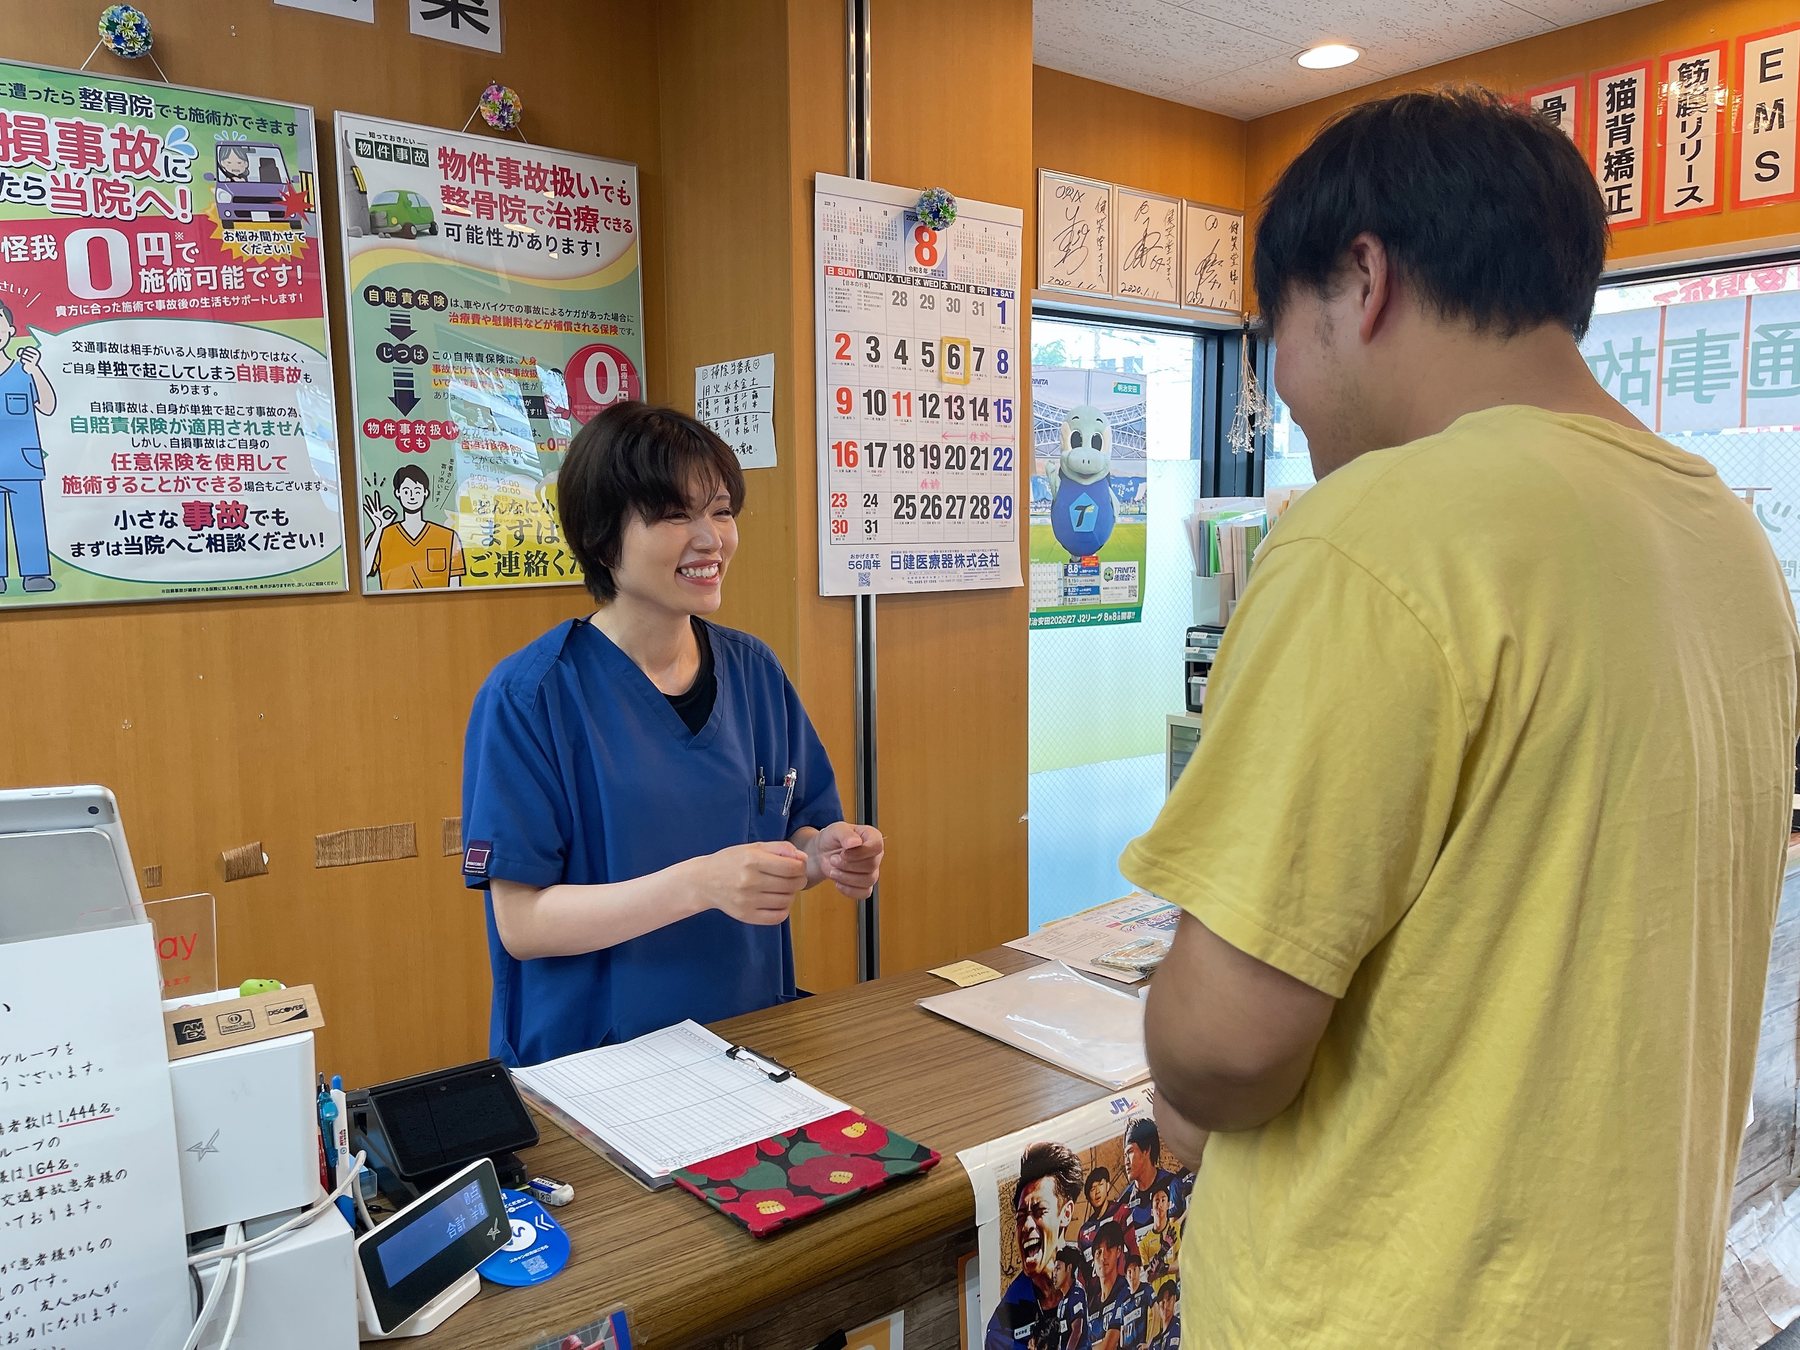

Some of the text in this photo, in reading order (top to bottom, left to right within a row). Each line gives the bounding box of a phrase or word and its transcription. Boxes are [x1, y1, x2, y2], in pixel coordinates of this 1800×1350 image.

[1754, 47, 1784, 182] EMS
[357, 141, 429, 166] 物件事故
[1602, 76, 1637, 217] 猫背矯正
[437, 146, 632, 207] 物件事故扱いでも
[440, 185, 634, 235] 整骨院で治療できる
[223, 230, 306, 243] お悩み聞かせて
[241, 243, 291, 255] ください!
[444, 222, 601, 258] 可能性があります!
[914, 225, 938, 267] 8
[138, 265, 304, 294] 施術可能です!
[837, 268, 855, 277] SUN
[867, 271, 885, 281] MON
[896, 275, 911, 285] TUE
[923, 279, 939, 289] WED
[951, 282, 964, 292] THU
[1000, 289, 1013, 298] SAT
[55, 293, 304, 317] 貴方に合った施術で事故後の生活もサポートします!
[367, 288, 446, 309] 自賠責保険
[892, 290, 908, 307] 28
[920, 294, 935, 310] 29
[946, 297, 961, 314] 30
[972, 301, 985, 316] 31
[997, 300, 1006, 325] 1
[449, 311, 635, 337] 治療費や慰謝料などが補償される保険です。
[72, 340, 305, 363] 交通事故は相手がいる人身事故ばかりではなく、
[382, 347, 425, 361] じつは
[834, 333, 1009, 374] 2 3 4 5 6 7 8
[62, 361, 312, 384] ご自身単独で起こしてしまう自損事故も
[168, 384, 219, 397] あります。
[836, 387, 1013, 424] 9 10 11 12 13 14 15
[131, 437, 270, 450] しかし、自損事故はご自身の
[399, 438, 428, 450] でも
[832, 441, 1013, 471] 16 17 18 19 20 21 22
[111, 452, 288, 473] 任意保険を使用して
[113, 500, 290, 531] 小さな事故でも
[831, 493, 1012, 520] 23 24 25 26 27 28 29
[832, 519, 878, 534] 30 31
[70, 532, 325, 558] まずは当院へご相談ください!
[848, 559, 881, 570] 56周年
[890, 552, 1000, 571] 日健医療器株式会社
[446, 1214, 467, 1239] 合計
